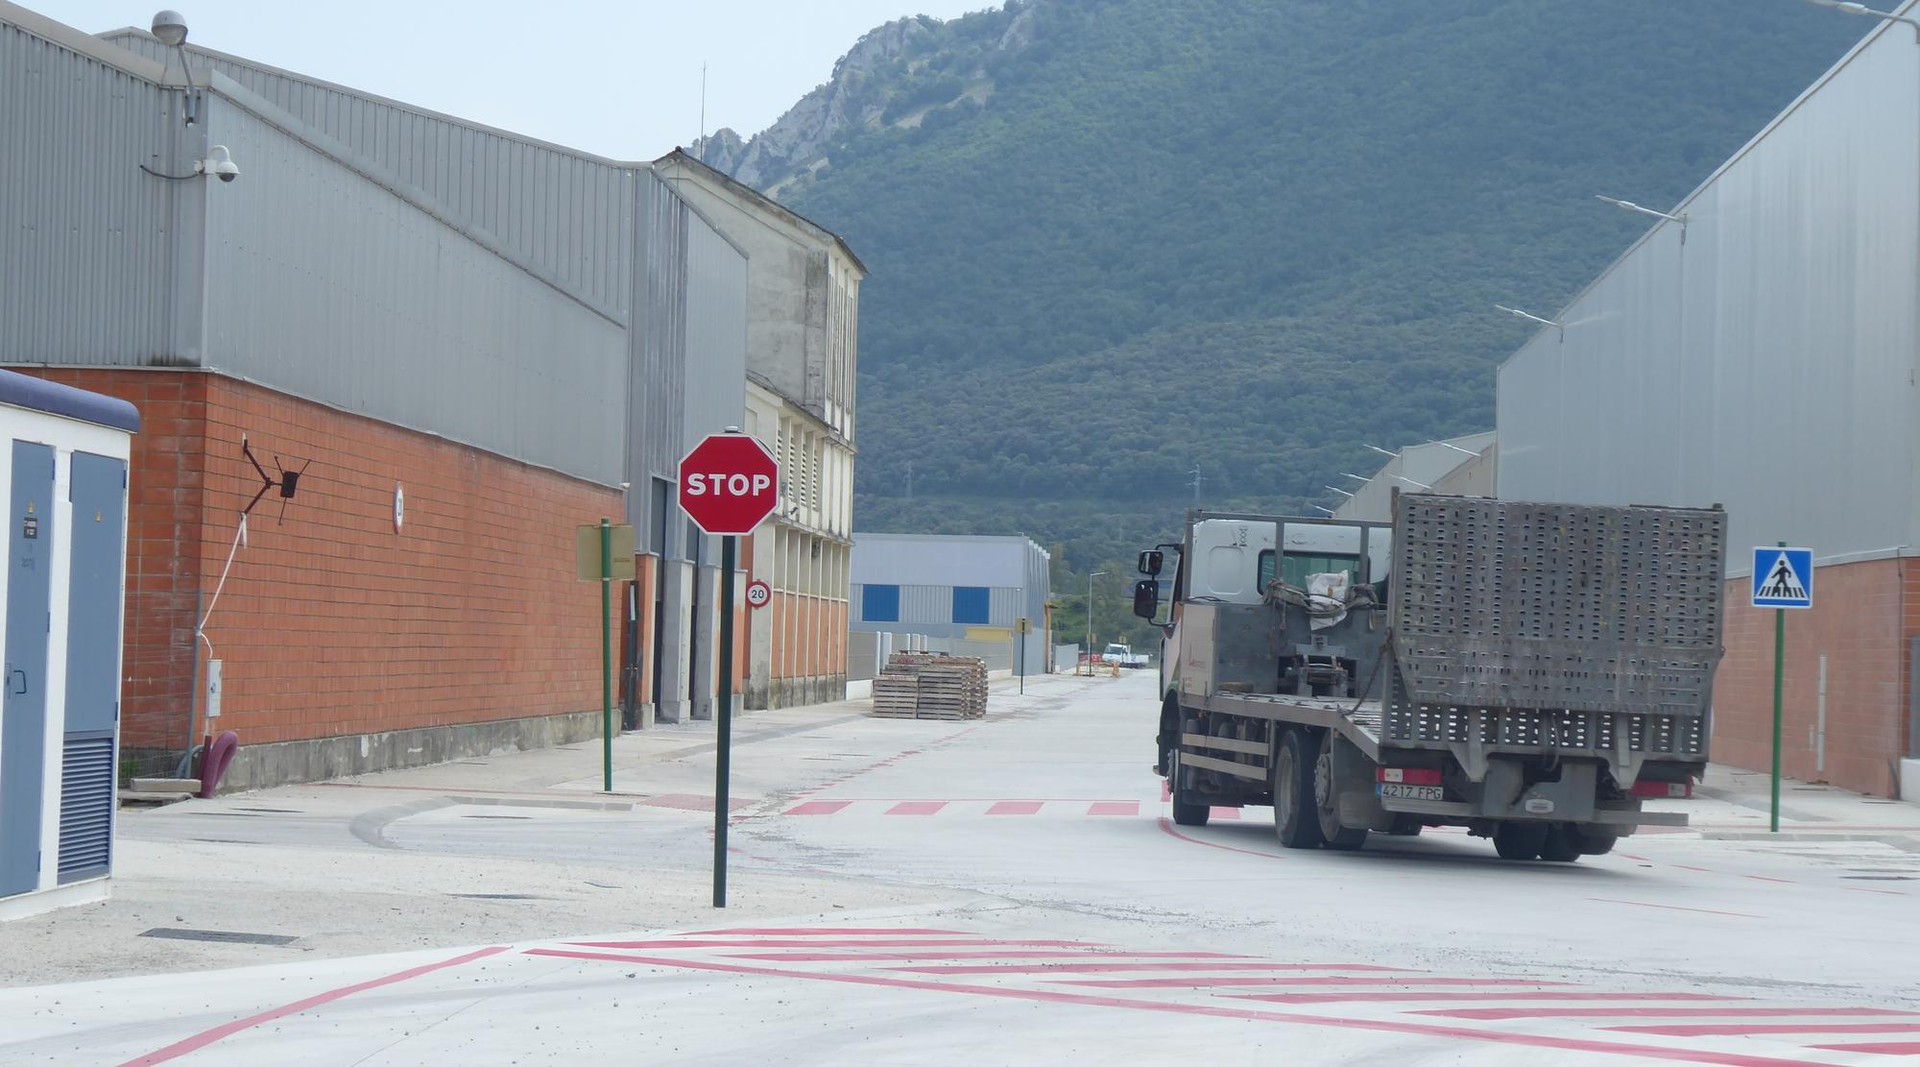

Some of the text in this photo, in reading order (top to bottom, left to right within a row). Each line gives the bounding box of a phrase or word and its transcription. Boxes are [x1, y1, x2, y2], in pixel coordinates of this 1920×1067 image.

[687, 473, 770, 496] STOP
[751, 589, 765, 599] 20
[1383, 784, 1442, 799] 4217 FPG
